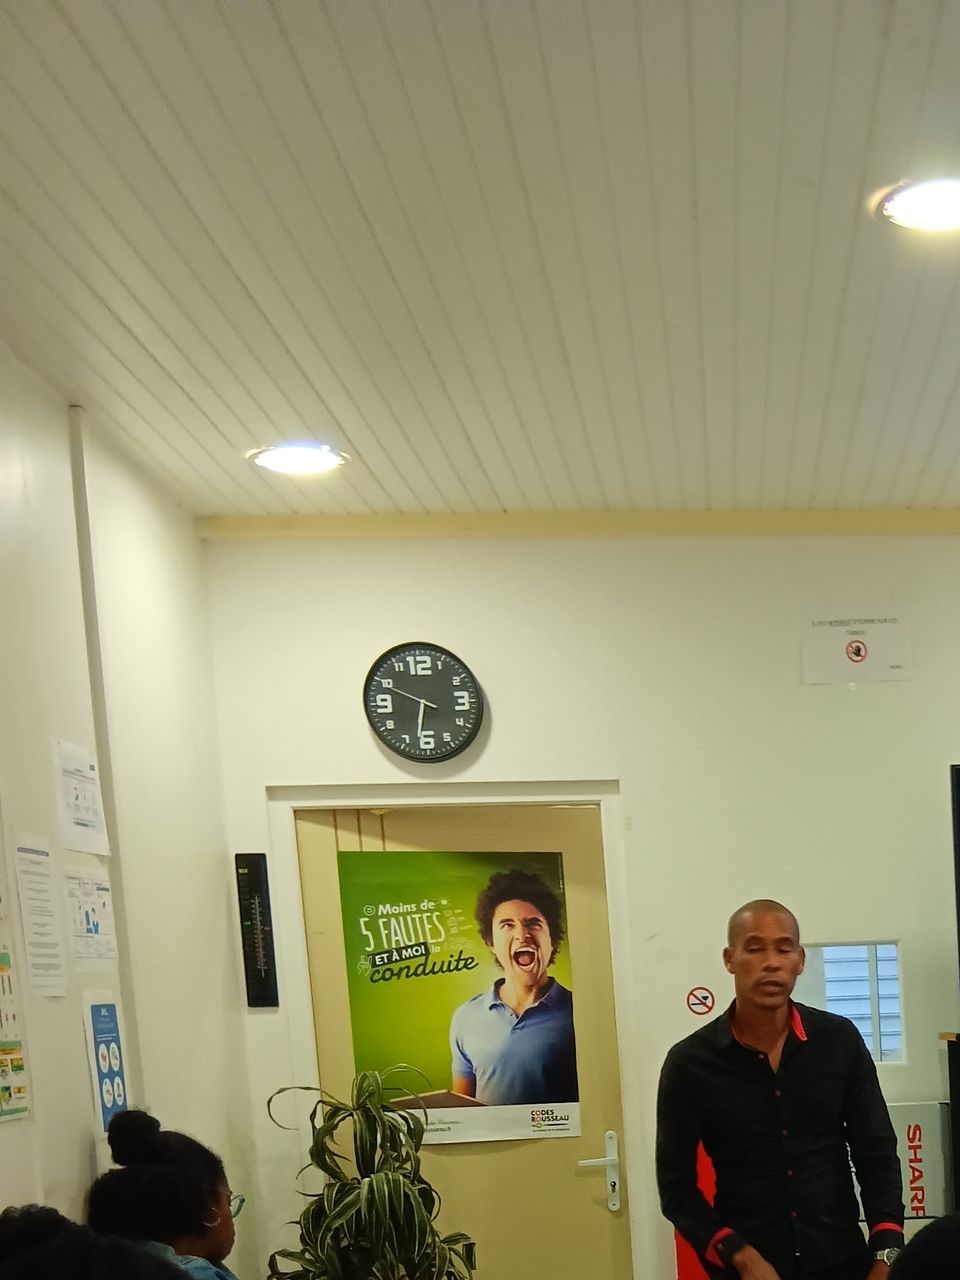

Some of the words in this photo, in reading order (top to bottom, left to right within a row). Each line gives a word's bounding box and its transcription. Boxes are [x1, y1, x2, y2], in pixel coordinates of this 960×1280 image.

[394, 662, 404, 672] 11
[406, 655, 432, 675] 12
[436, 661, 442, 670] 1
[381, 678, 393, 688] 10
[452, 676, 461, 686] 2
[376, 694, 393, 713] 9
[453, 691, 470, 711] 3
[385, 720, 395, 729] 8
[455, 717, 464, 726] 4
[401, 734, 410, 744] 7
[420, 730, 435, 750] 6
[442, 732, 451, 742] 5
[378, 903, 417, 915] Moins
[420, 899, 436, 911] de
[359, 917, 374, 951] 5
[378, 911, 446, 949] FAUTES
[375, 953, 389, 966] ET
[392, 949, 400, 961] À
[402, 945, 426, 959] MOI
[370, 950, 478, 983] conduite
